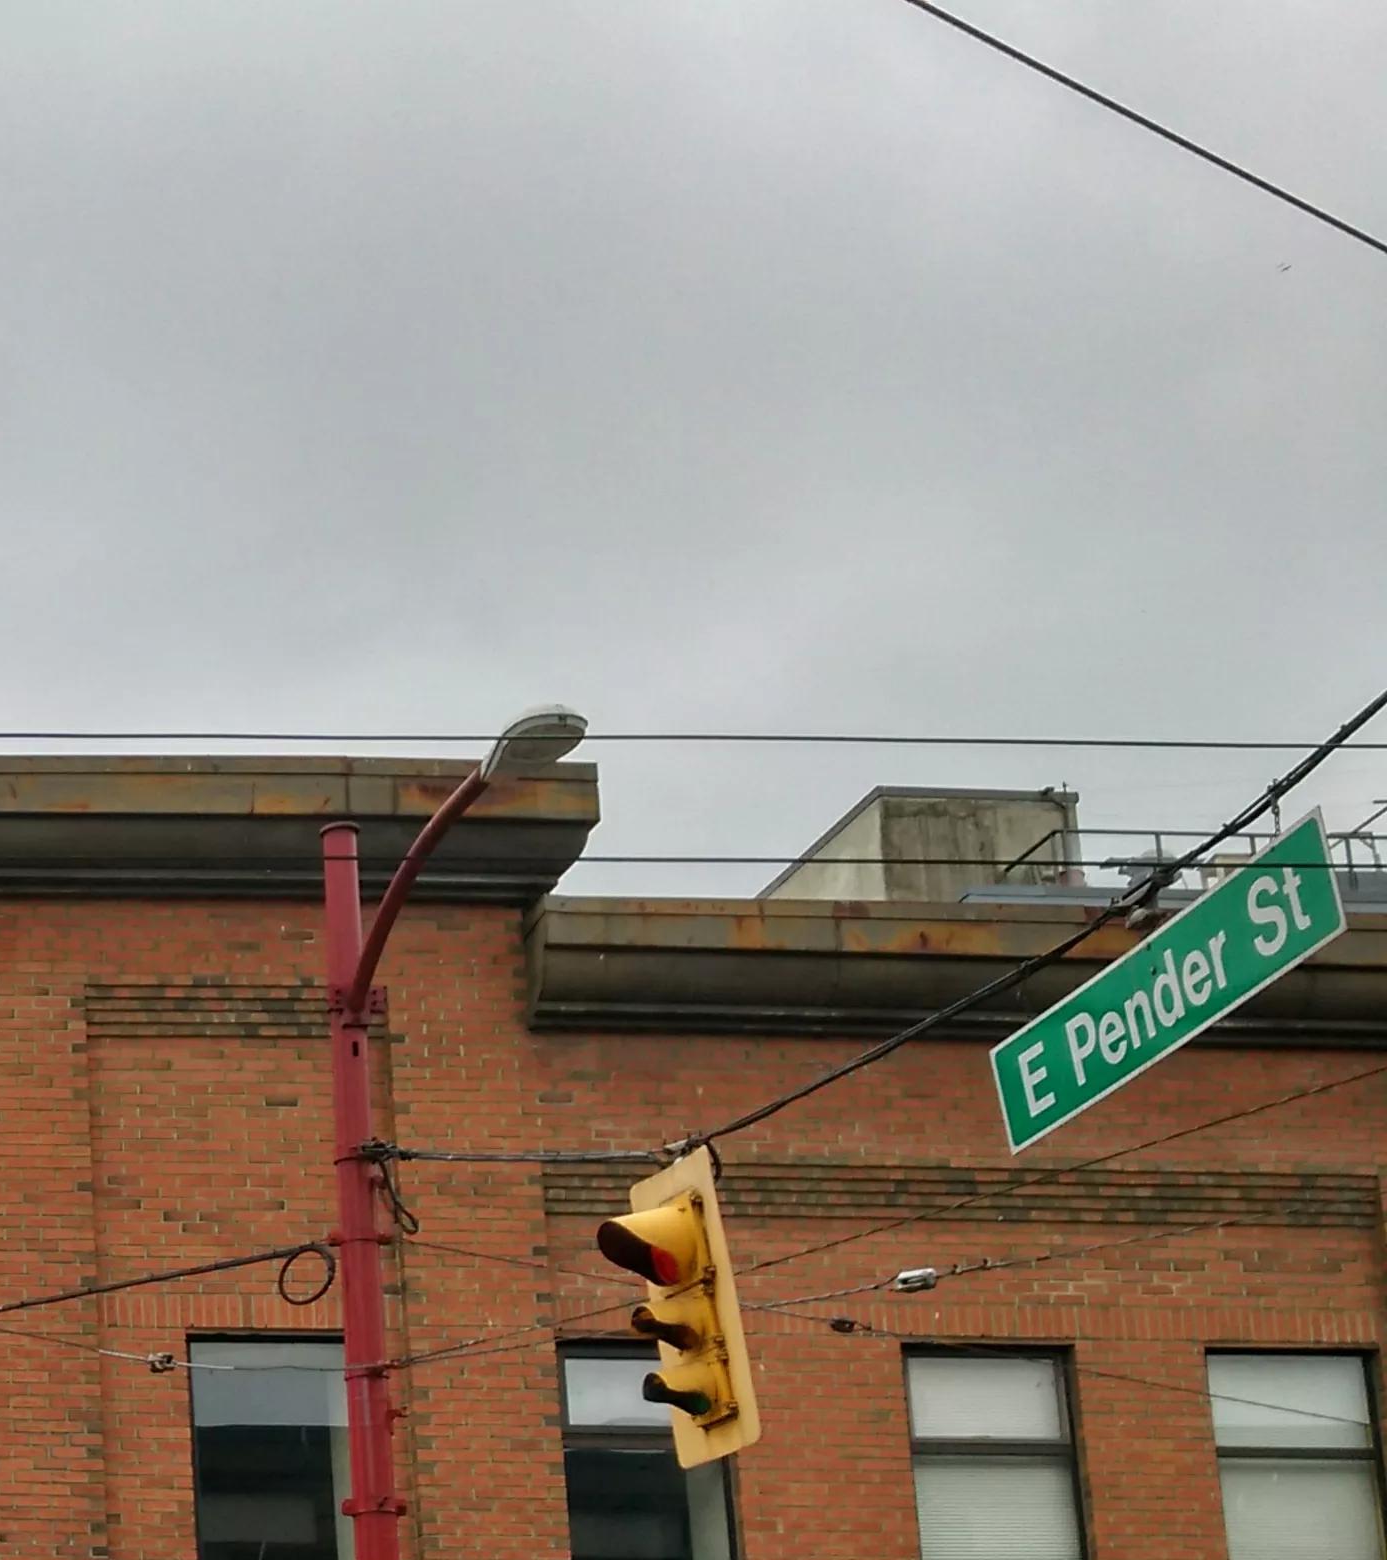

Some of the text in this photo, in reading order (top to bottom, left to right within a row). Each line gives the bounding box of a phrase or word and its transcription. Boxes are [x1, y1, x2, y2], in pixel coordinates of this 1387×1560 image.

[1018, 864, 1311, 1118] E Pender St
